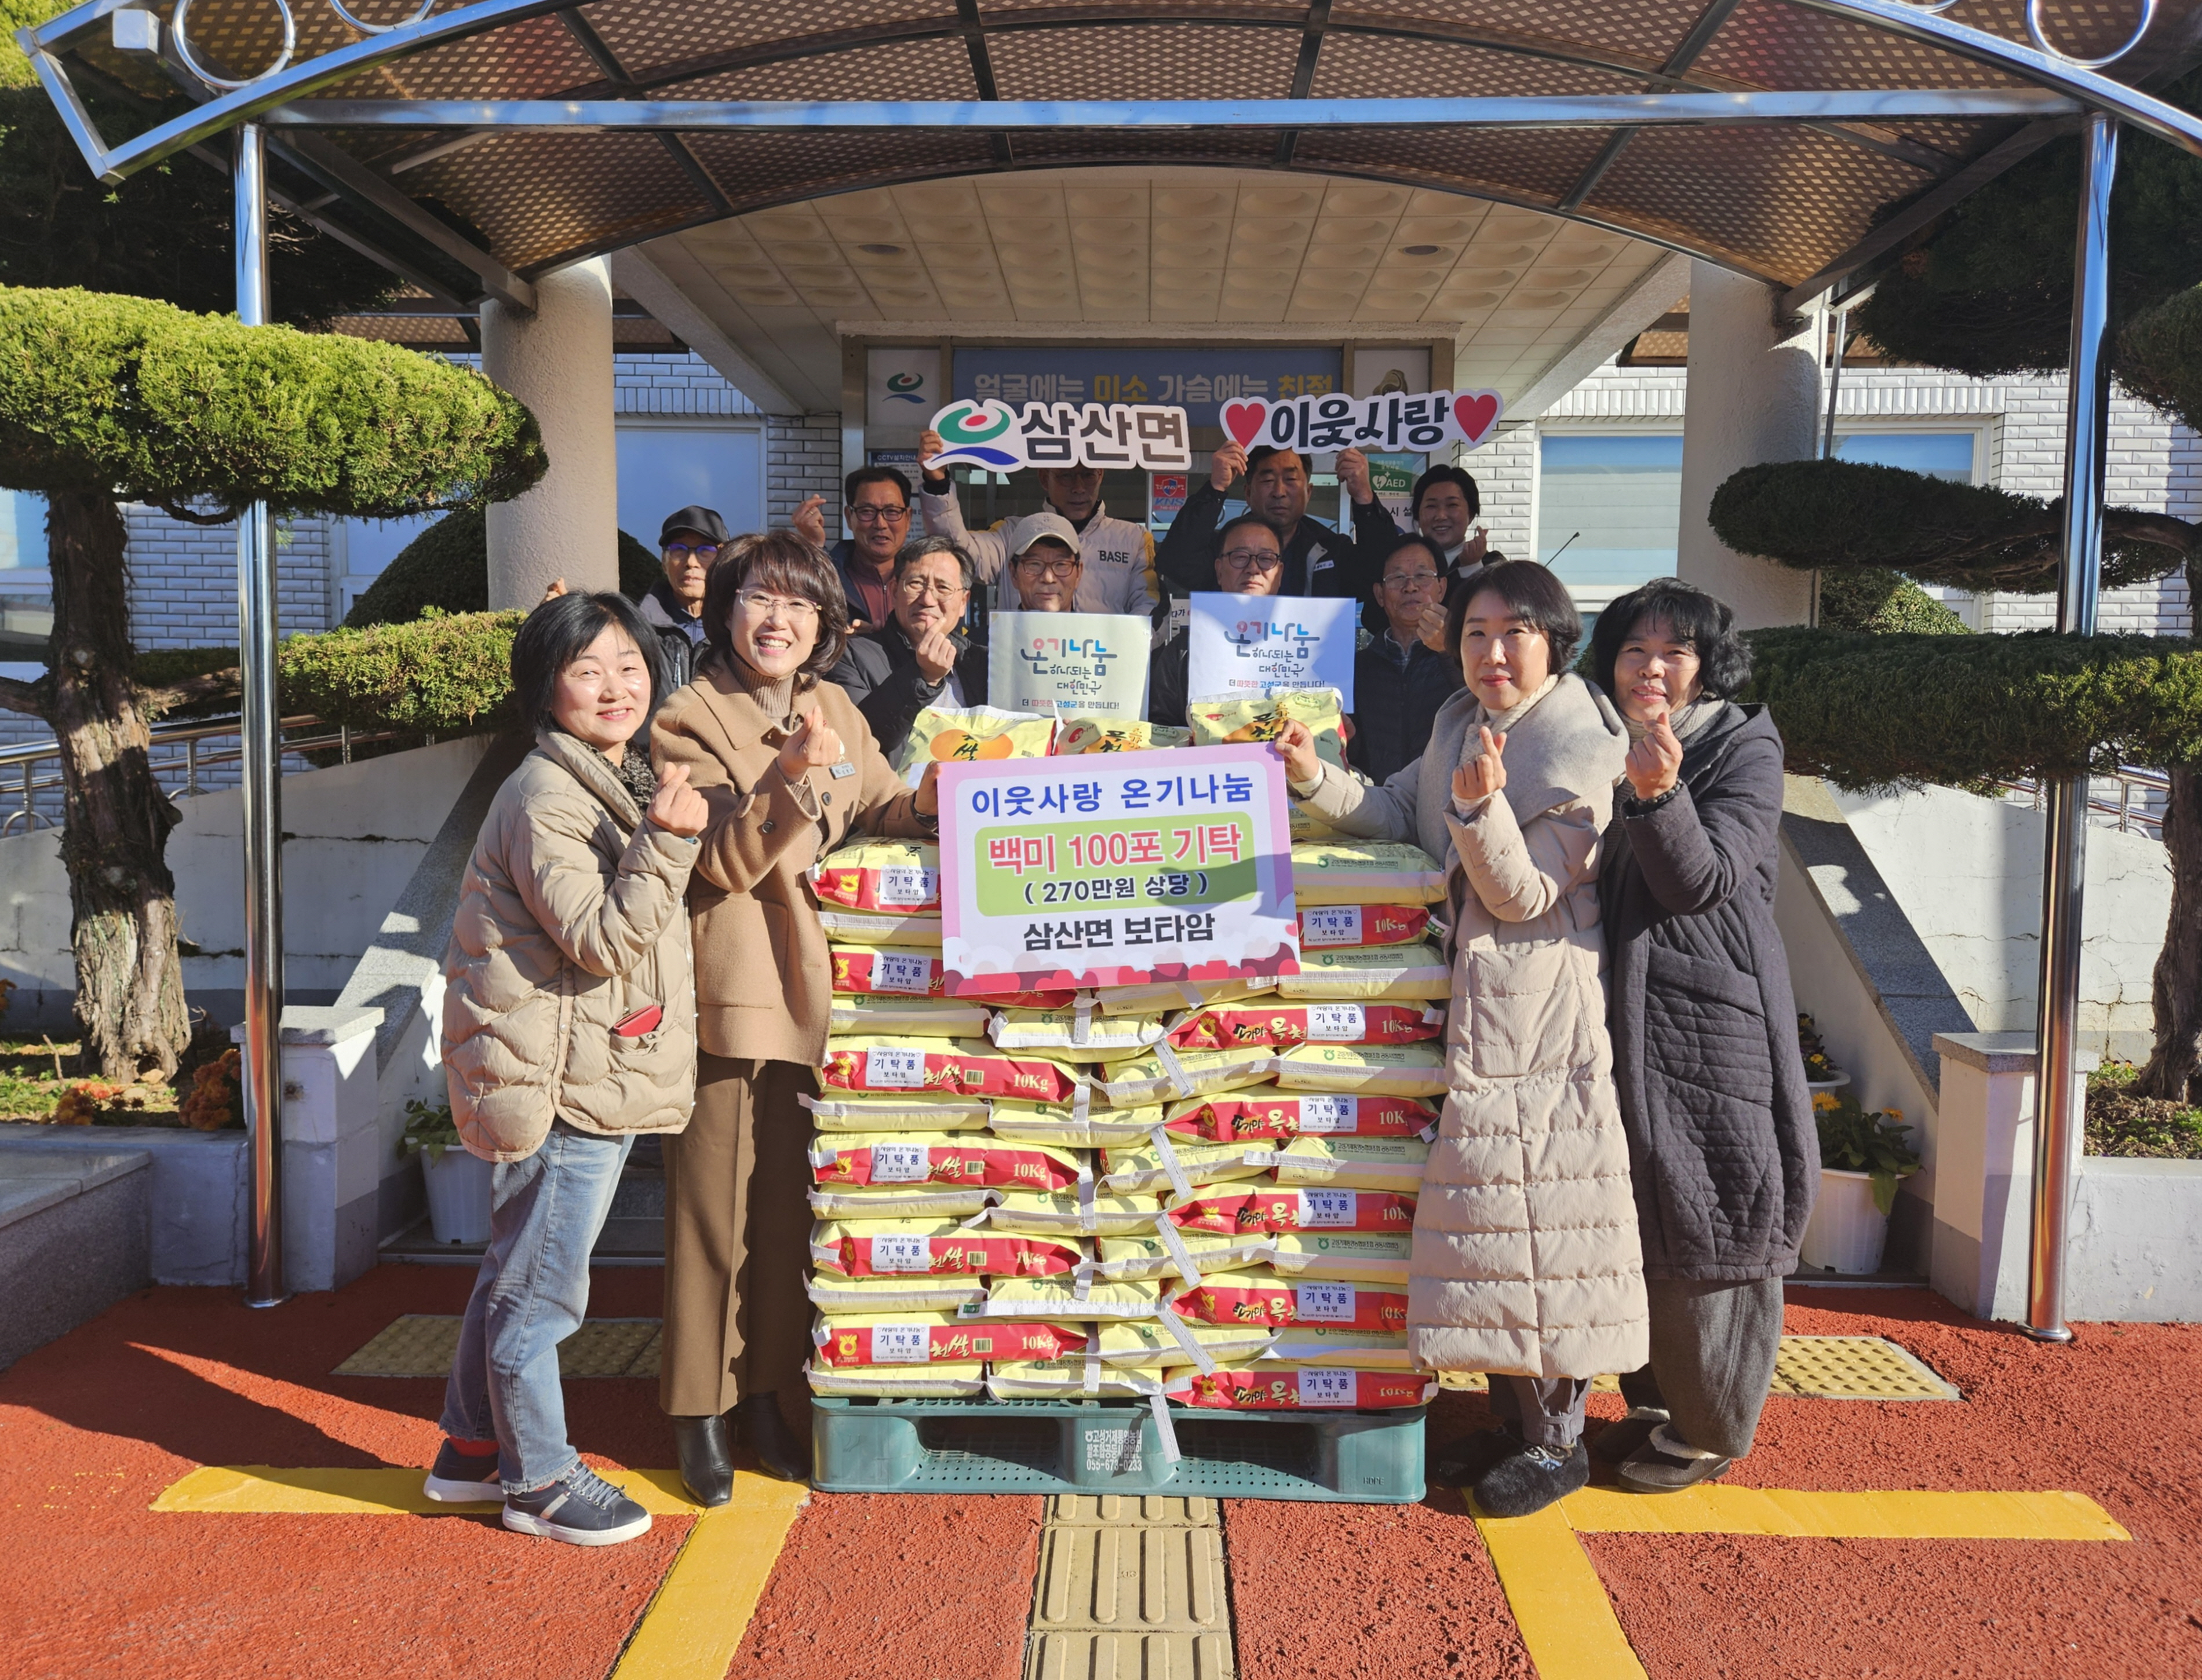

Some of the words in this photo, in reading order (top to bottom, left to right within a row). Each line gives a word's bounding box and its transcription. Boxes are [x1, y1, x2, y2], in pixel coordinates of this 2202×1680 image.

[975, 375, 1084, 402] 얼굴에는
[1094, 375, 1147, 401] 미소
[1158, 375, 1268, 403] 가슴에는
[1271, 396, 1450, 448] 이웃사랑
[1021, 410, 1185, 463] 삼산면
[1386, 479, 1406, 488] AED
[1098, 550, 1130, 564] BASE
[1224, 621, 1320, 659] 온기나눔
[1020, 638, 1117, 676] 온기나눔
[1252, 647, 1294, 662] 하나되는
[1050, 664, 1091, 680] 하나되는
[1259, 663, 1304, 678] 대한민국
[1057, 680, 1102, 695] 대한민국
[1237, 680, 1258, 688] 따뜻한
[1056, 700, 1085, 708] 고성군을
[1088, 701, 1120, 710] 만듭니다!
[972, 781, 1102, 817] 이웃사랑
[1121, 773, 1253, 809] 온기나눔
[989, 835, 1055, 875] 백미
[1068, 831, 1164, 867] 100포
[1173, 823, 1242, 863] 기탁
[1043, 878, 1135, 902] 270만원
[1145, 874, 1190, 897] 상당
[1023, 919, 1114, 951] 삼산면
[1124, 914, 1216, 945] 보타암
[1375, 918, 1405, 933] 10Kg
[1382, 1019, 1413, 1035] 10Kg
[1013, 1073, 1049, 1093] 10Kg
[1013, 1163, 1046, 1181] 10Kg
[1381, 1307, 1408, 1320] 10K
[1022, 1335, 1053, 1350] 10Kg
[1087, 1459, 1142, 1471] 055-673-0233
